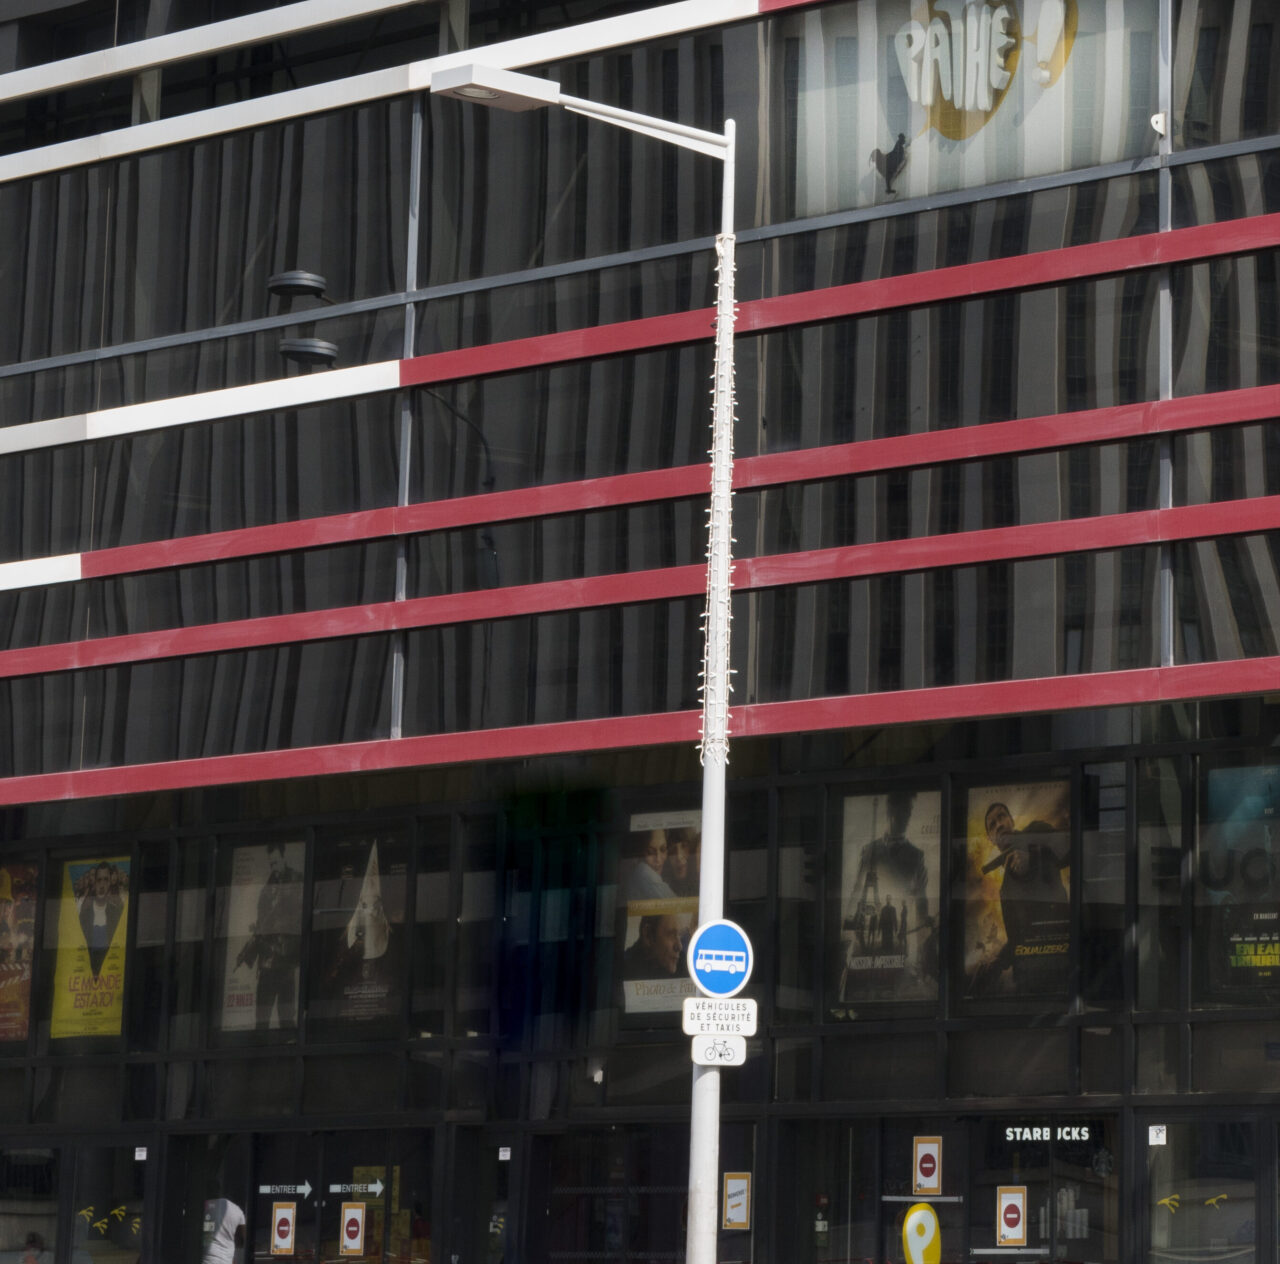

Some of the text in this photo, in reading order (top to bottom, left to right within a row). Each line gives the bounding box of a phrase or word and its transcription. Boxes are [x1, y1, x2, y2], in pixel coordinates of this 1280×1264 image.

[68, 974, 121, 992] LE MONDE
[695, 1002, 747, 1011] VÉHICULES
[690, 1012, 751, 1022] DE SÉCURITÉ
[700, 1023, 741, 1032] ET TAXIS
